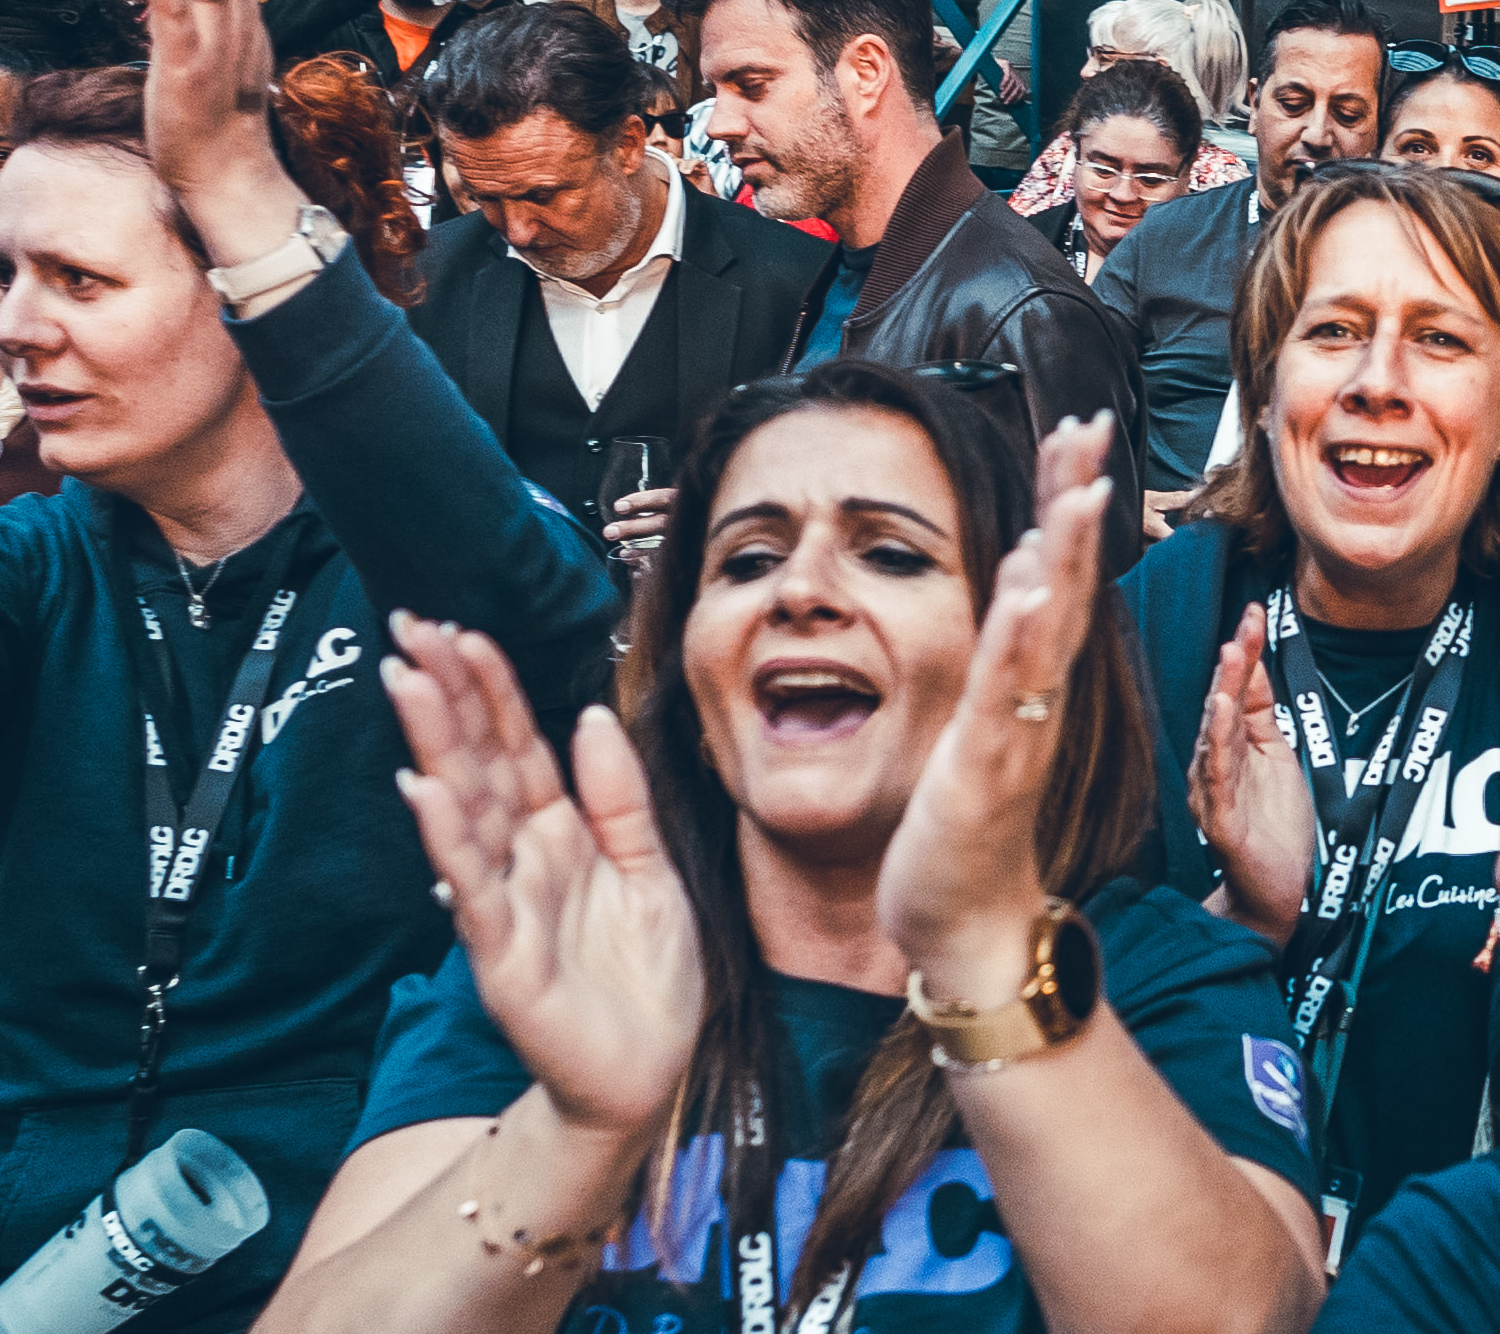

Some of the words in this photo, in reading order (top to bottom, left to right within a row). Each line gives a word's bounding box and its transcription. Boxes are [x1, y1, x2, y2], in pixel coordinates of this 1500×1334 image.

[252, 589, 297, 651] DRDLC
[1424, 602, 1464, 666] DRDLC
[208, 703, 255, 773] DRDLC
[1296, 691, 1337, 768] DRDLC
[1402, 706, 1448, 783] DRDLC
[163, 827, 210, 901] DRDLC
[1318, 844, 1358, 920] DRDLC
[1385, 882, 1414, 914] Les
